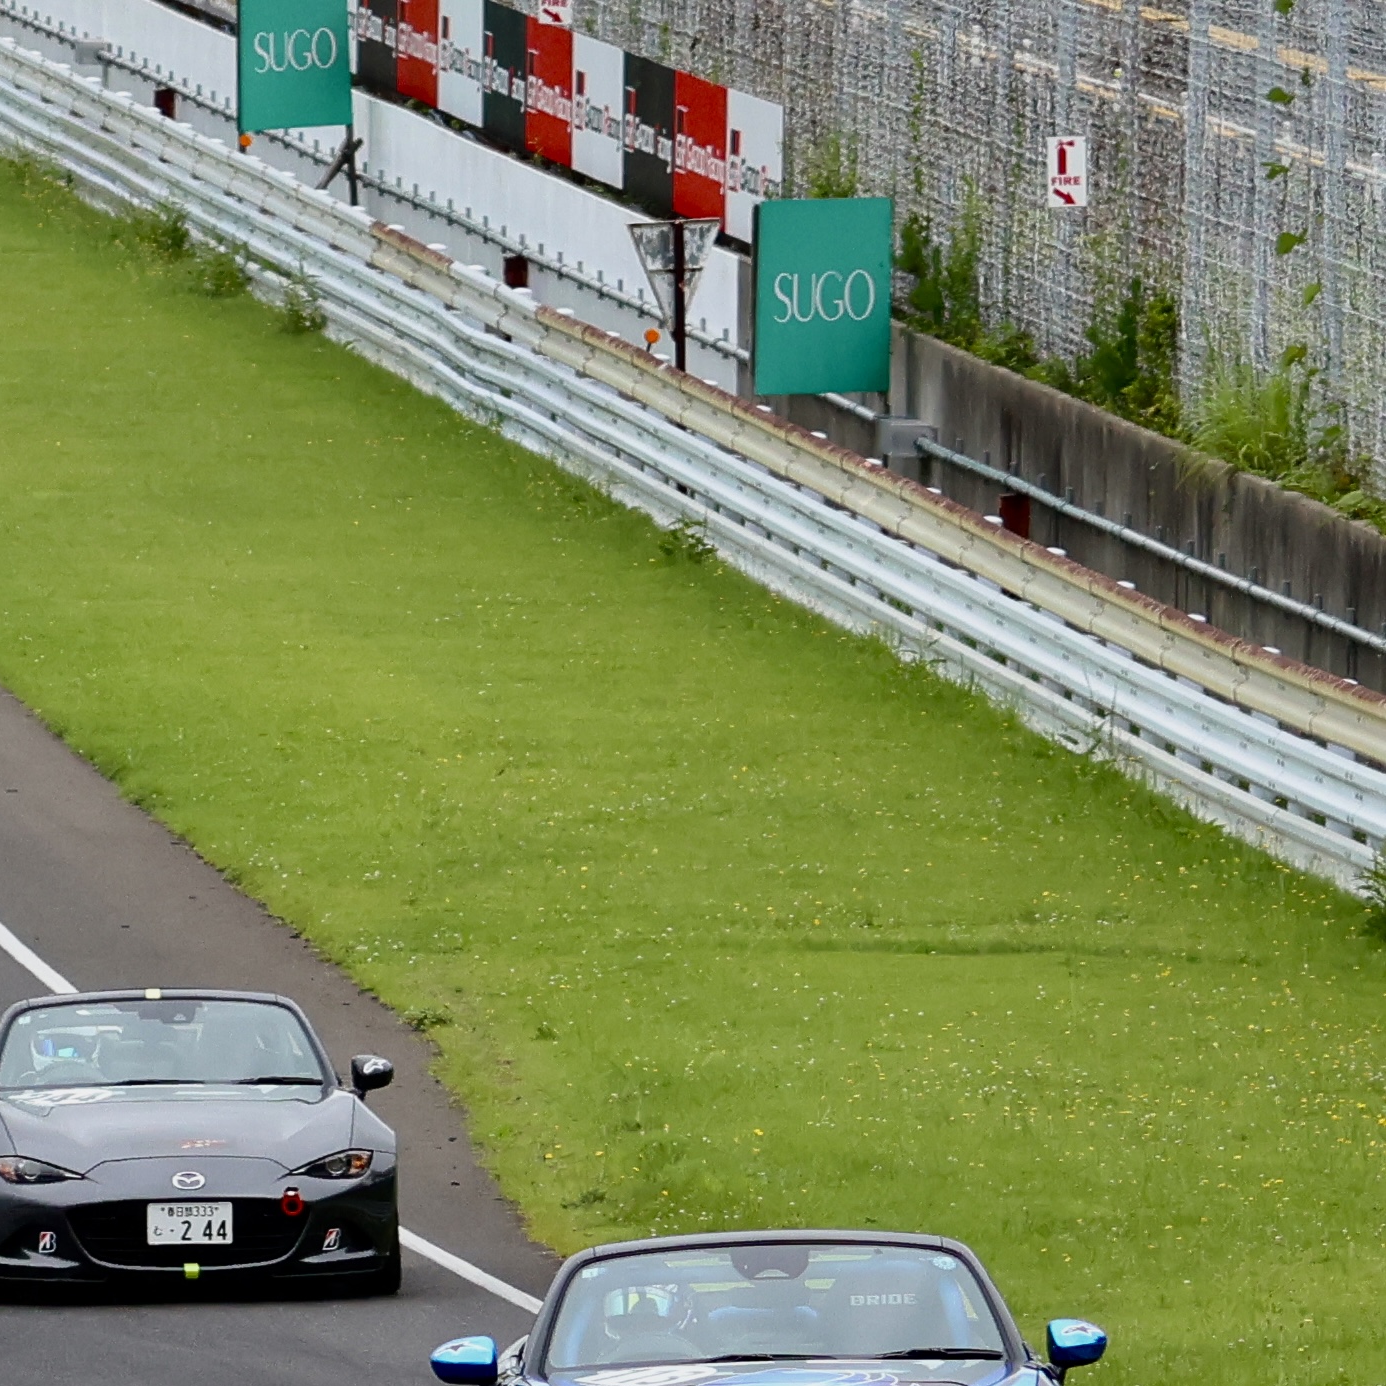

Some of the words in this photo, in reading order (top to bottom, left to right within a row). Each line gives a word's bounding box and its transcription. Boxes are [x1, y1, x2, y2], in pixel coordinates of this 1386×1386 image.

[254, 27, 338, 74] SUGO
[1051, 176, 1082, 187] FIRE
[773, 268, 876, 323] SUGO
[850, 1293, 917, 1306] BRIDE
